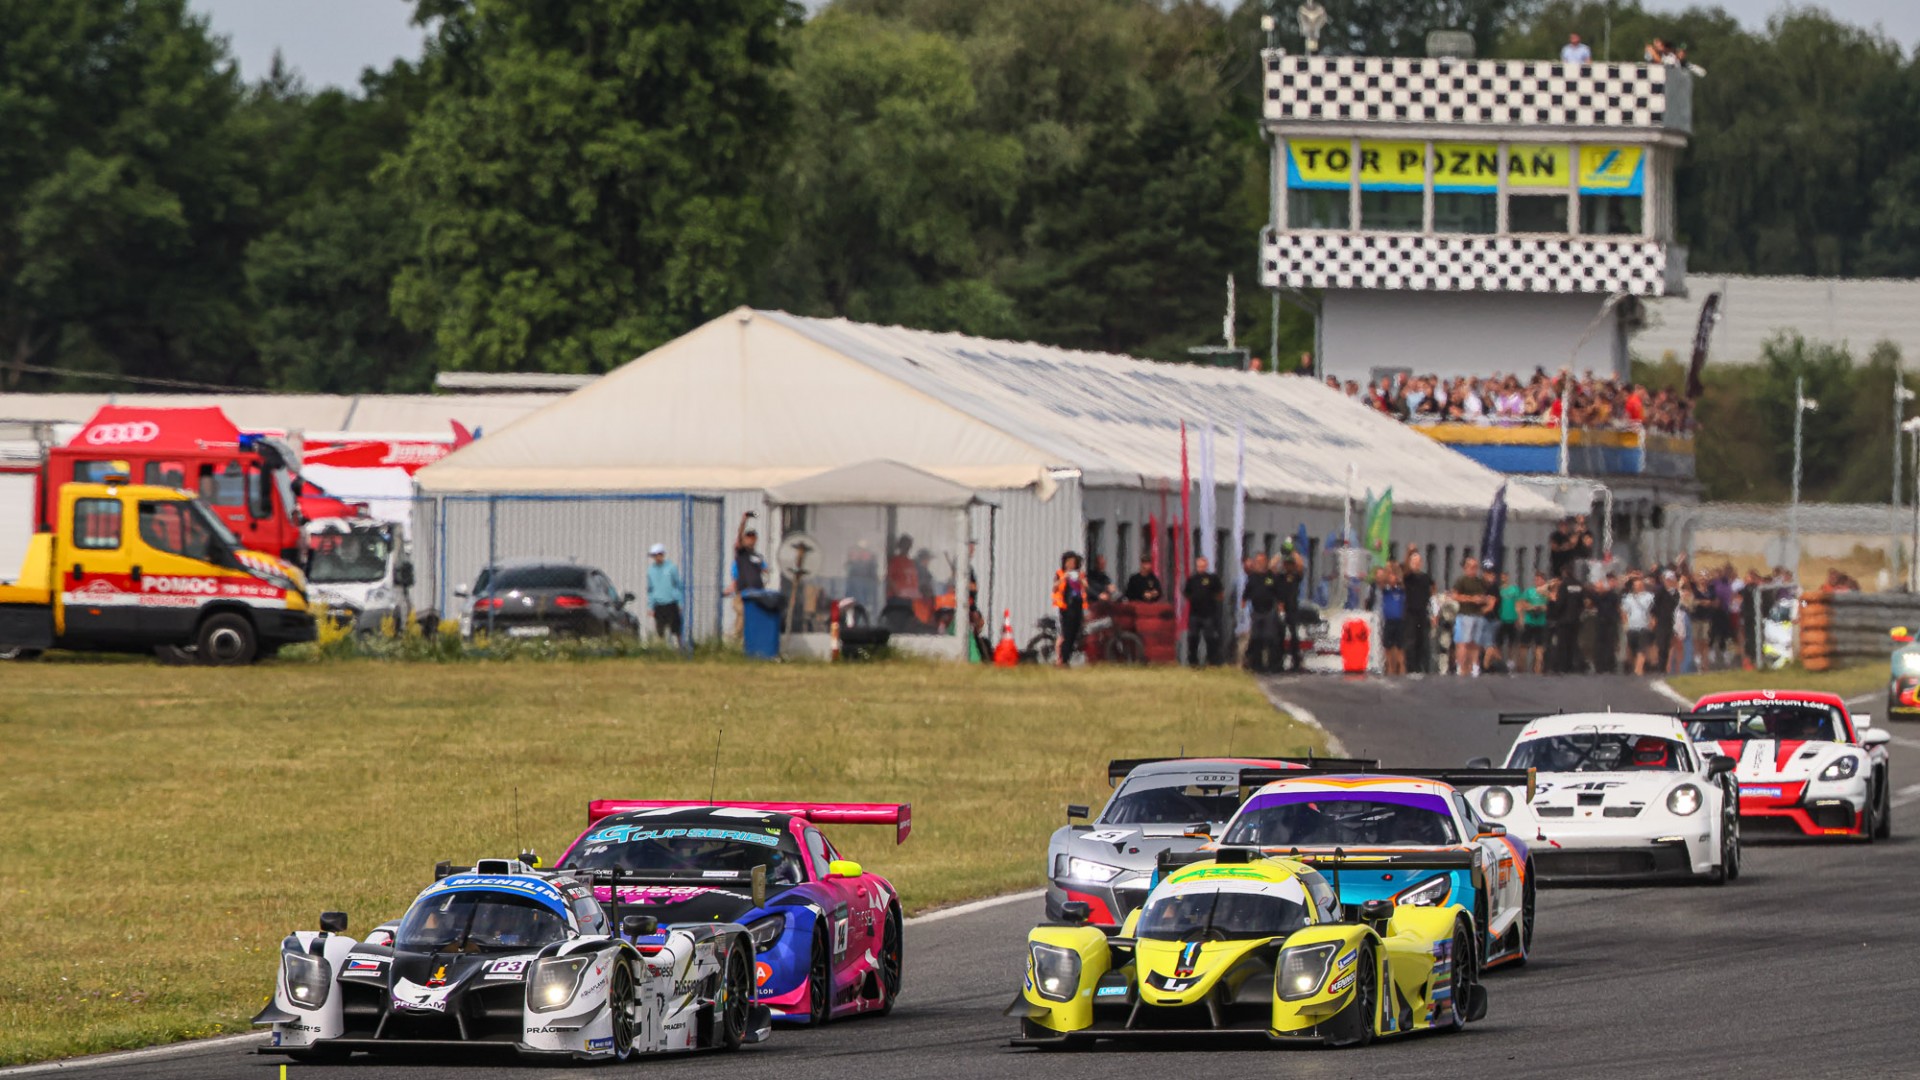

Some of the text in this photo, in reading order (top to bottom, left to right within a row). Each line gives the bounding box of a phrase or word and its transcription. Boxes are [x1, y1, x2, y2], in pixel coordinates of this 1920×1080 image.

[1301, 145, 1556, 177] TOR POZNAŃ
[141, 575, 218, 594] POMOC
[1752, 698, 1802, 707] Centrum
[631, 828, 684, 842] CUP
[686, 828, 780, 846] SERIES
[452, 877, 561, 901] MICHELIN
[492, 960, 523, 972] P3
[1164, 978, 1188, 992] 4
